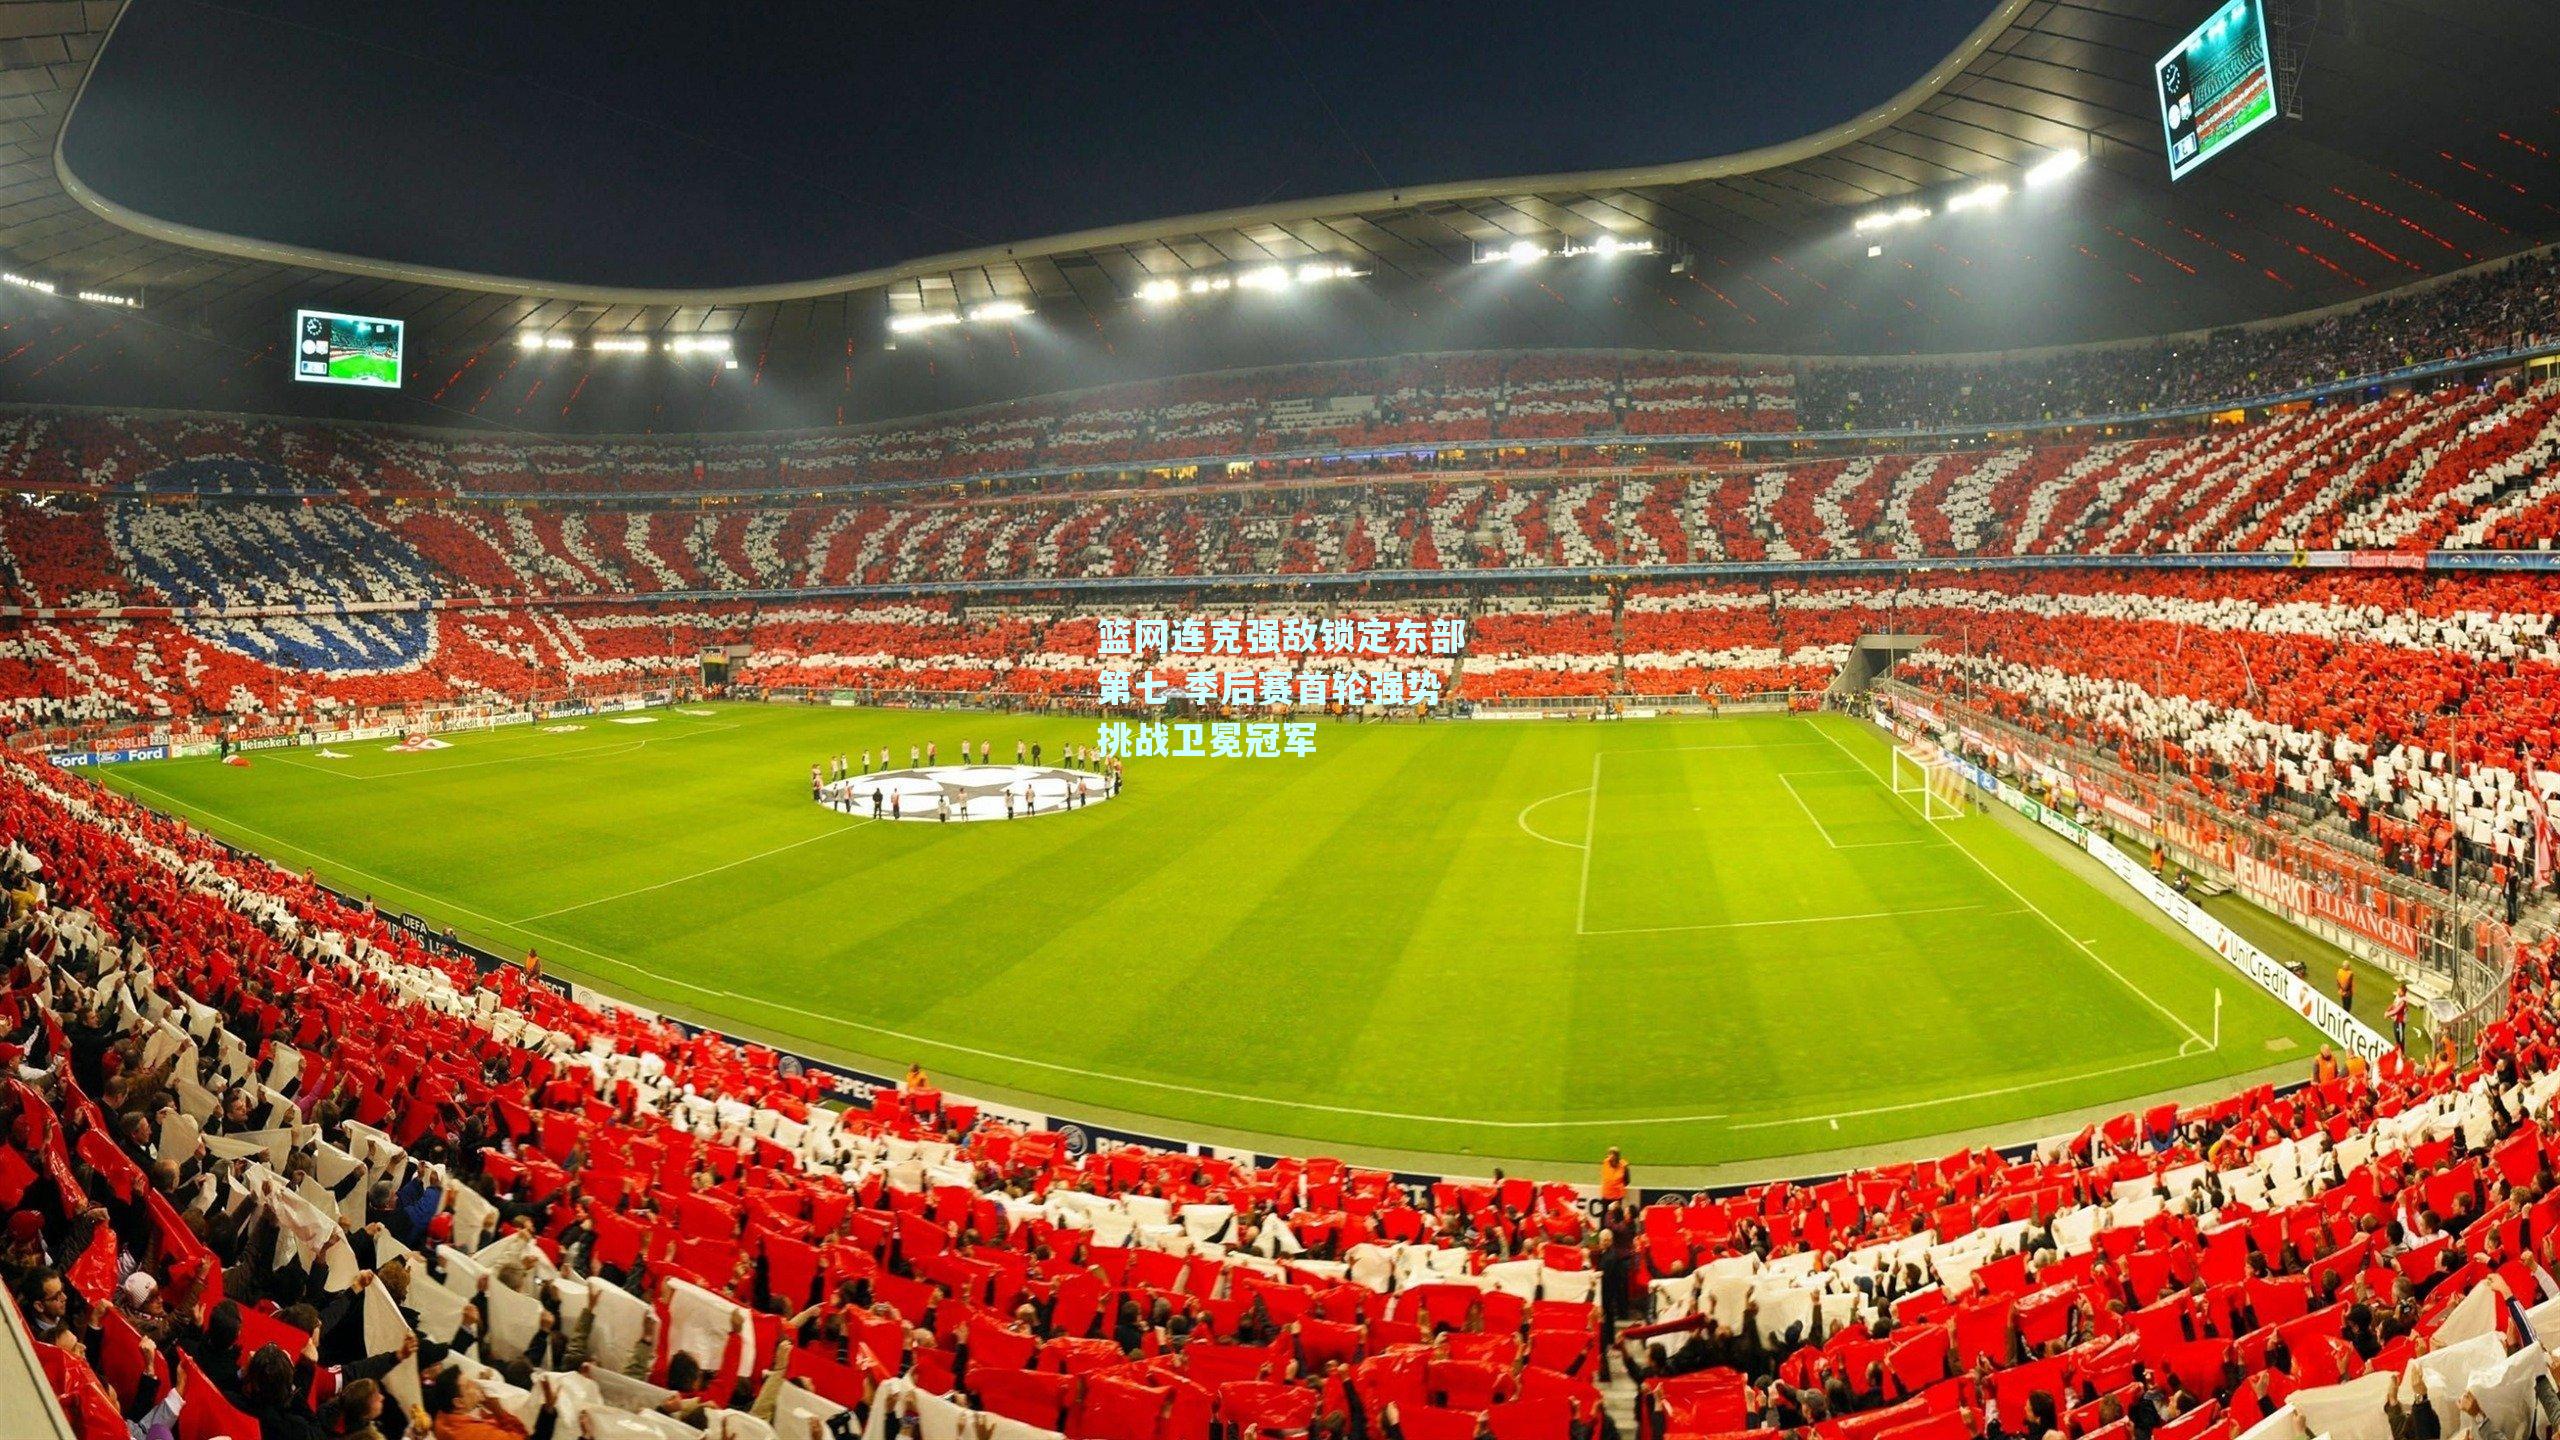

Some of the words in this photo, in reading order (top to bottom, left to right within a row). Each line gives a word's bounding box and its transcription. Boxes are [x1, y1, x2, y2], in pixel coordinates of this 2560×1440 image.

[240, 739, 288, 752] Heineken
[52, 754, 88, 768] Ford
[128, 749, 163, 762] Ford
[402, 915, 428, 935] UEFA
[2316, 888, 2416, 953] ELLWANGEN
[2230, 936, 2289, 1000] UniCredit
